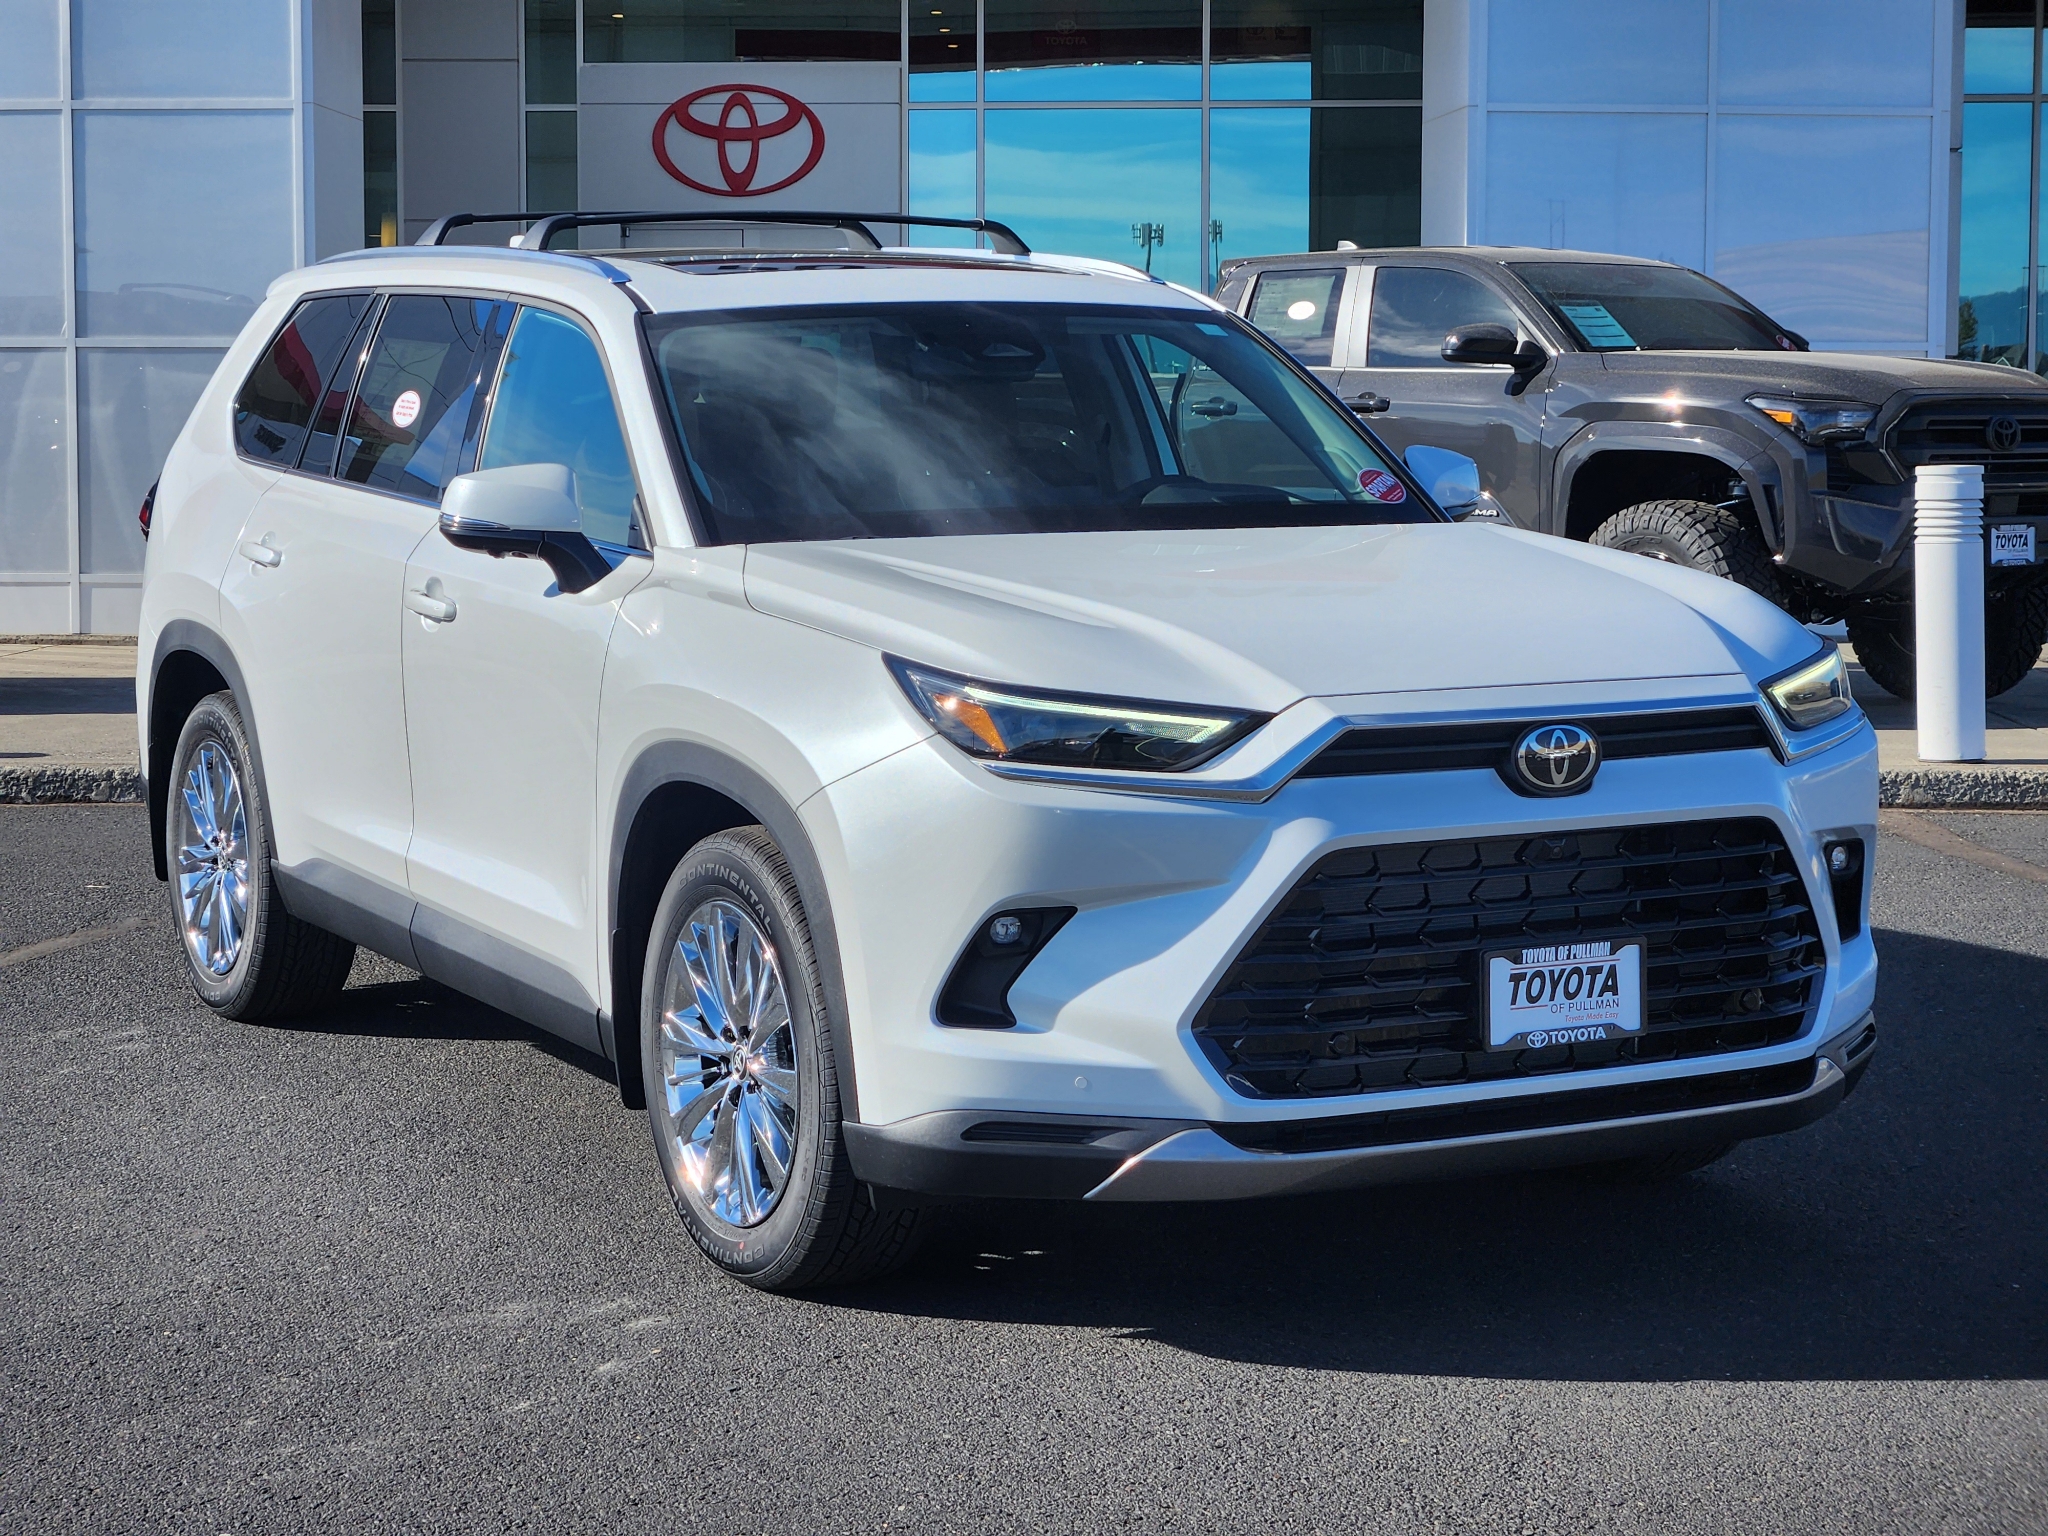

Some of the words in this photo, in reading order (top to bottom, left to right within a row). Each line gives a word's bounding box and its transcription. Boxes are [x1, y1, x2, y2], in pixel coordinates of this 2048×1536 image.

[1044, 36, 1088, 46] TOYOTA
[1995, 534, 2028, 548] TOYOTA
[679, 863, 772, 935] CONTINENTAL
[1521, 946, 1556, 964] TOYOTA
[1557, 945, 1569, 961] OF
[1570, 941, 1611, 960] PULLMAN
[1508, 963, 1619, 1006] TOYOTA
[1550, 1003, 1565, 1014] OF
[1568, 998, 1620, 1012] PULLMAN
[1565, 1014, 1584, 1023] Toyota
[1585, 1012, 1603, 1021] Made
[1605, 1011, 1619, 1020] Easy
[1549, 1026, 1606, 1044] TOYOTA
[671, 1185, 765, 1265] CONTINENTAL
